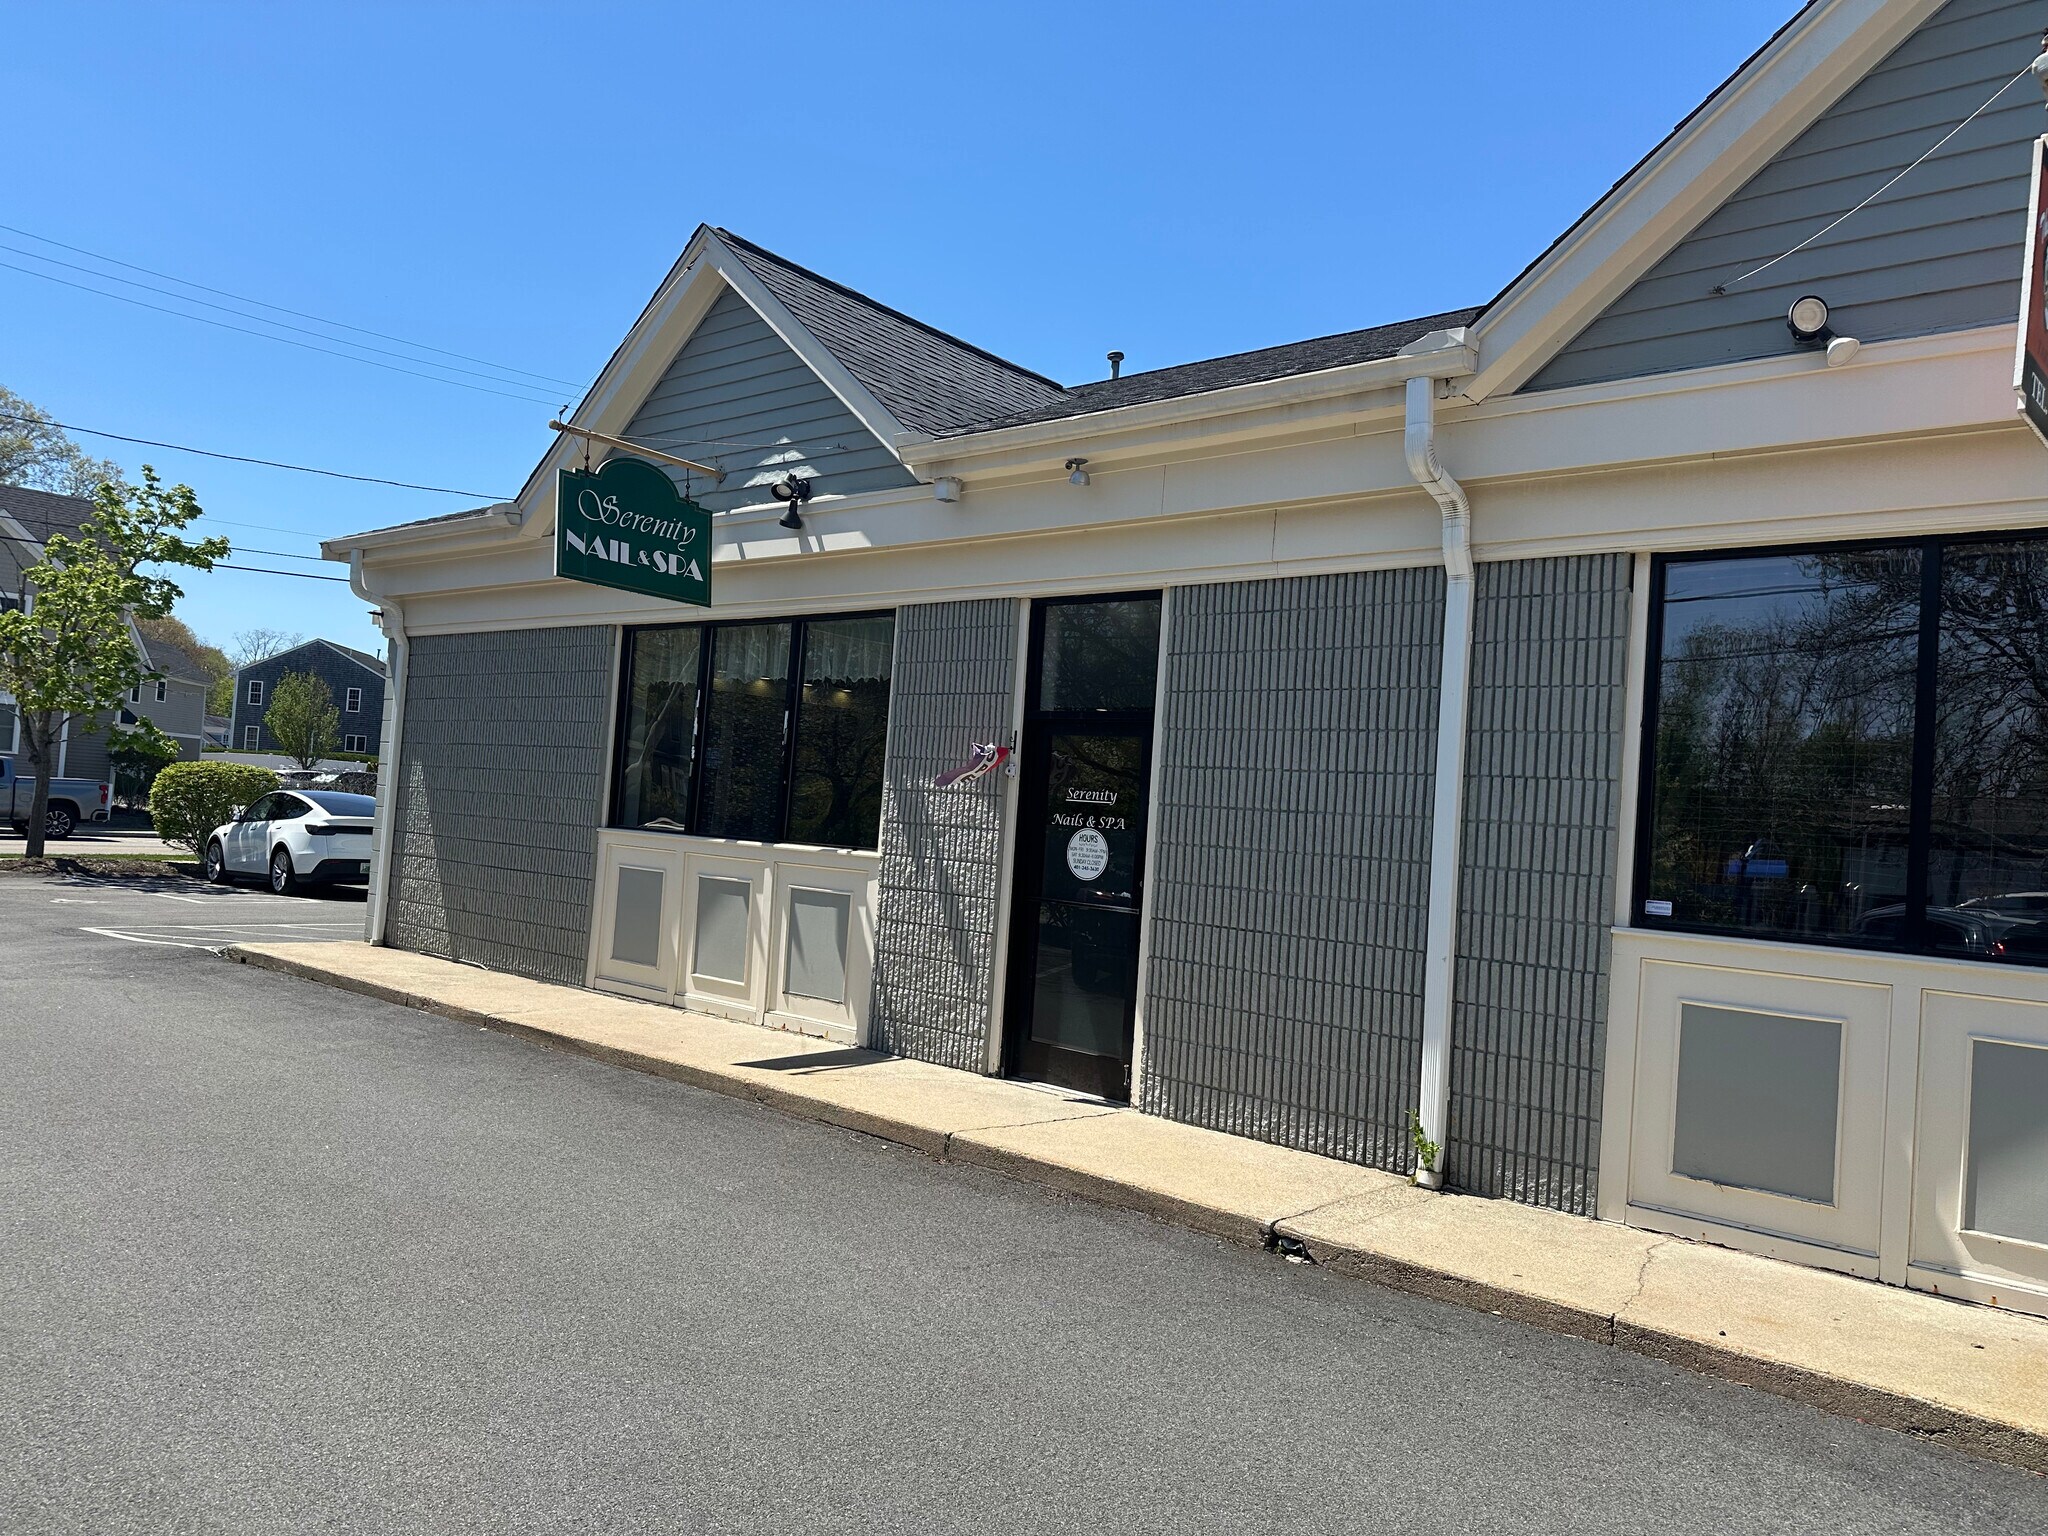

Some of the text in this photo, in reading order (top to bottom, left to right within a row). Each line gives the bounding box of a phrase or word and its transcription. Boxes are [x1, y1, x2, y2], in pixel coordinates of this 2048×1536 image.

[578, 489, 696, 552] Serenity
[566, 528, 704, 582] NAIL & SPA
[960, 750, 995, 782] OPE
[1066, 787, 1118, 806] Serenity
[1051, 813, 1126, 830] Nails & SPA
[1079, 833, 1099, 844] HOURS
[1072, 857, 1102, 867] SUNDAY CLOSED
